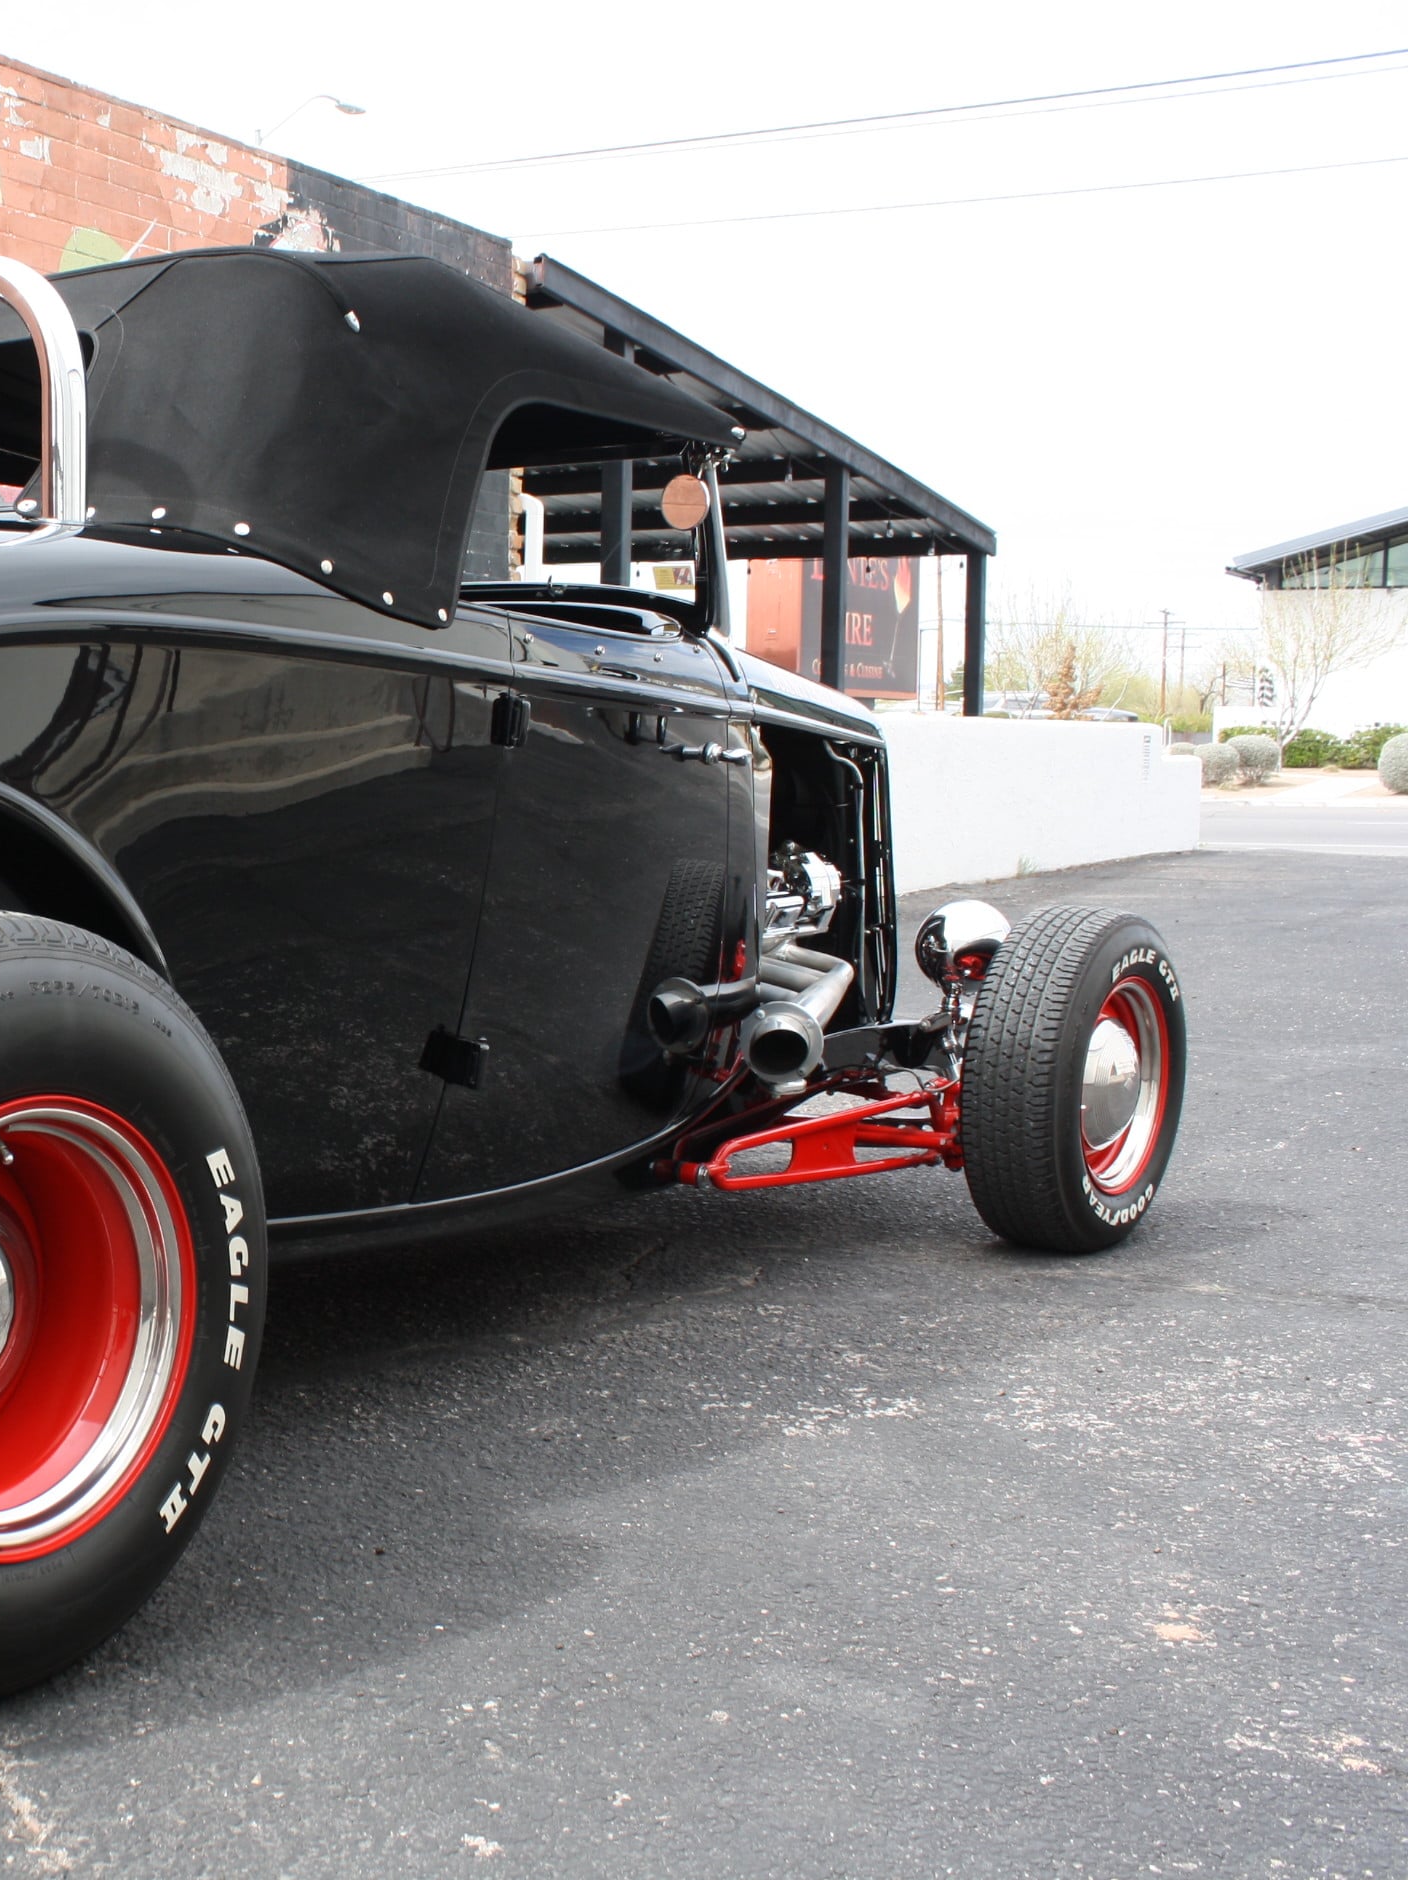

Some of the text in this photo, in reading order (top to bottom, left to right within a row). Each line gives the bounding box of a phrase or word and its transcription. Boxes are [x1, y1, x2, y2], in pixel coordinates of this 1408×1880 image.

[1112, 948, 1156, 983] EAGLE
[1082, 1175, 1153, 1226] GOODYEAR
[204, 1147, 250, 1371] EAGLE
